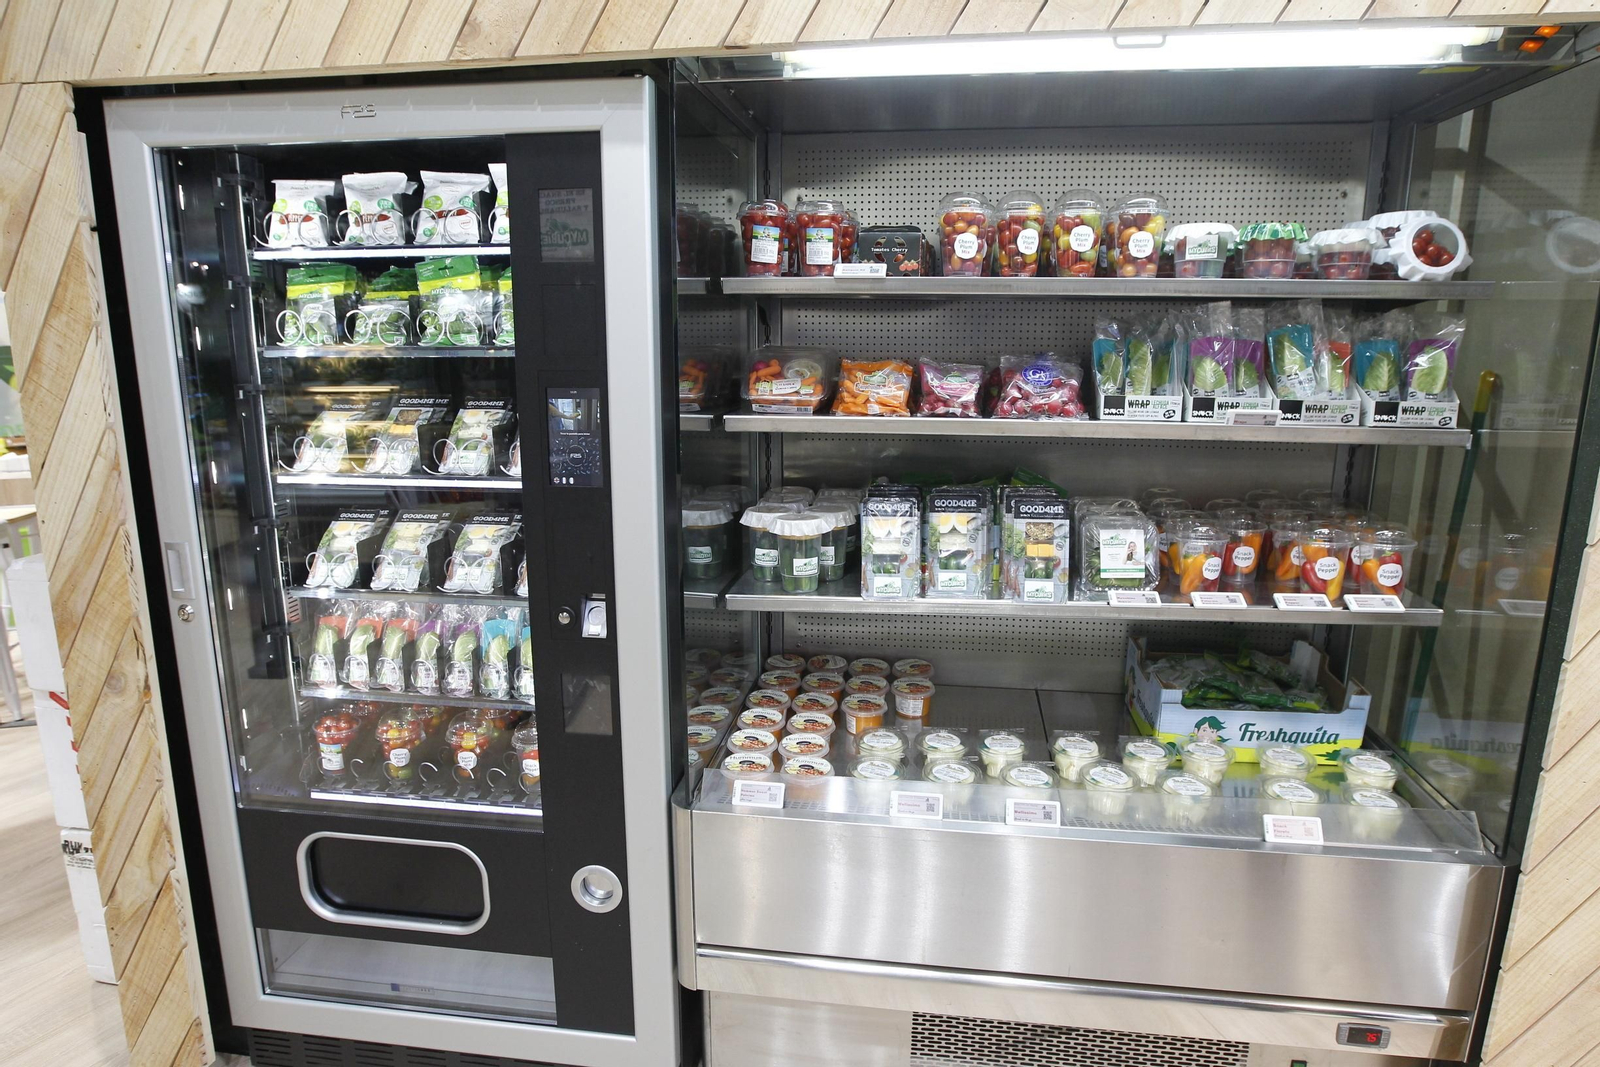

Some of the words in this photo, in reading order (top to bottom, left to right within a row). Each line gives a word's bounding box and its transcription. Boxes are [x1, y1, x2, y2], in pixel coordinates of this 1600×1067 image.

[1127, 400, 1151, 409] WRAP
[1217, 401, 1240, 411] WRAP
[1305, 404, 1329, 414] WRAP
[1401, 406, 1427, 416] WRAP
[868, 502, 911, 511] GOOD4ME
[934, 499, 977, 507] GOOD4ME
[1020, 503, 1065, 514] GOOD4ME
[1239, 723, 1341, 745] Freshquita
